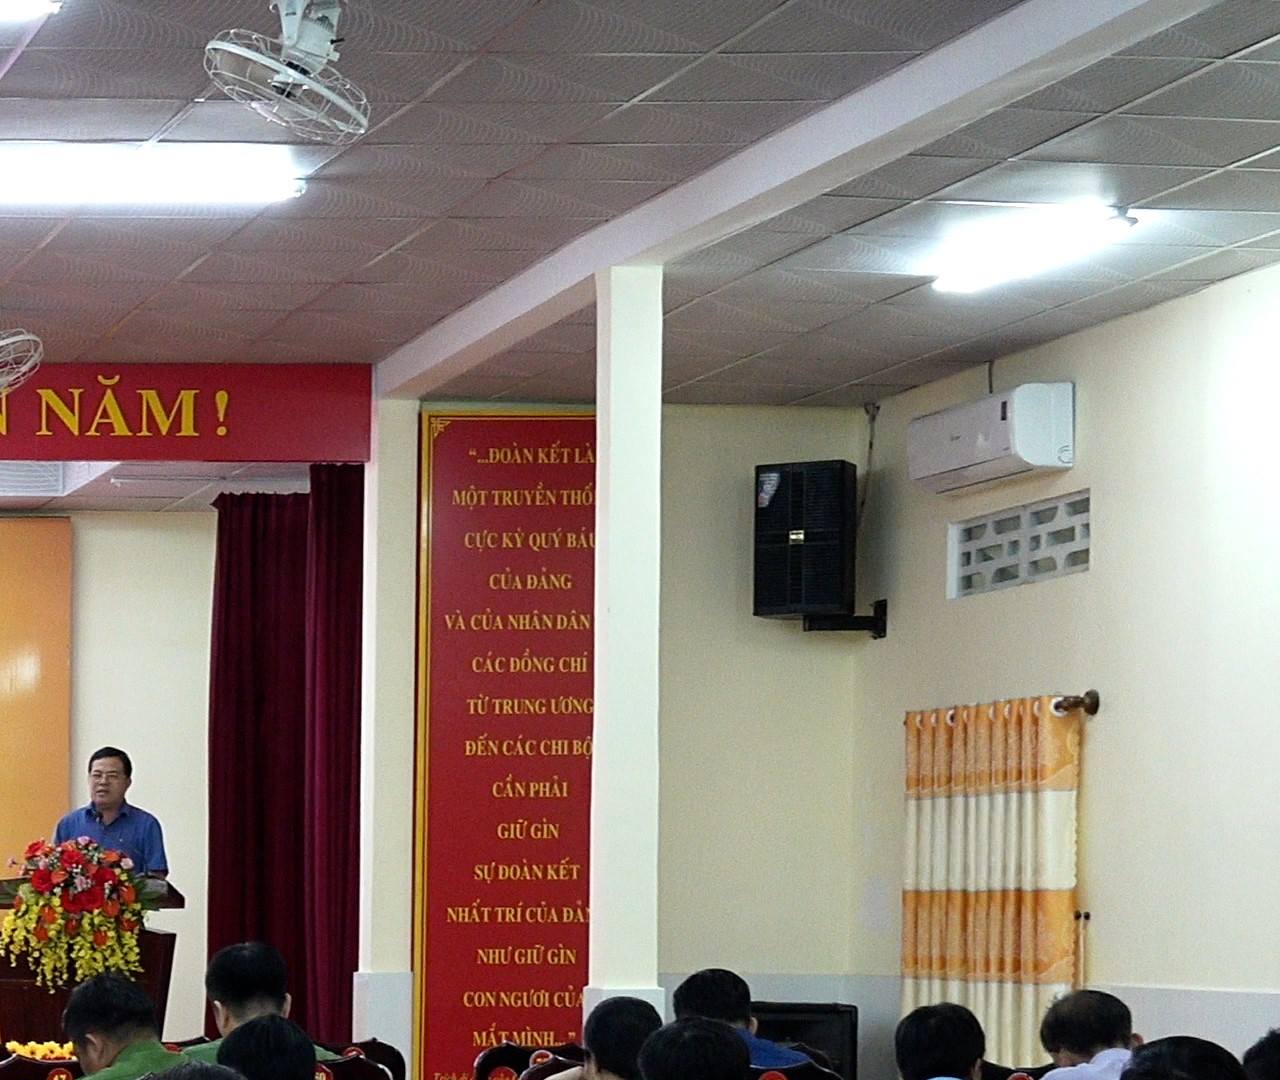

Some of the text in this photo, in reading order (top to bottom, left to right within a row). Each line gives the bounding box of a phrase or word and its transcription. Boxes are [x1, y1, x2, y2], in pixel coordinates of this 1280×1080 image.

[36, 375, 199, 436] NĂM
[539, 440, 571, 464] KẾT
[575, 444, 595, 464] LÀ
[490, 568, 572, 589] CỦA ĐẢNG
[445, 608, 590, 631] VÀ CỦA NHÂN DÂN
[472, 649, 588, 673] CÁC ĐỒNG CHÍ
[467, 694, 594, 715] TỪ TRUNG ƯƠNG
[465, 733, 593, 759] ĐẾN CÁC CHI BỘ
[493, 774, 568, 798] CẦN PHẢI
[497, 818, 559, 839] GIỮ GÌN
[474, 857, 580, 884] SỰ ĐOÀN KẾT
[477, 944, 576, 964] NHƯ GIỮ GÌN
[464, 985, 584, 1008] CON NGƯƠI CỦA
[473, 1023, 512, 1047] MẮT
